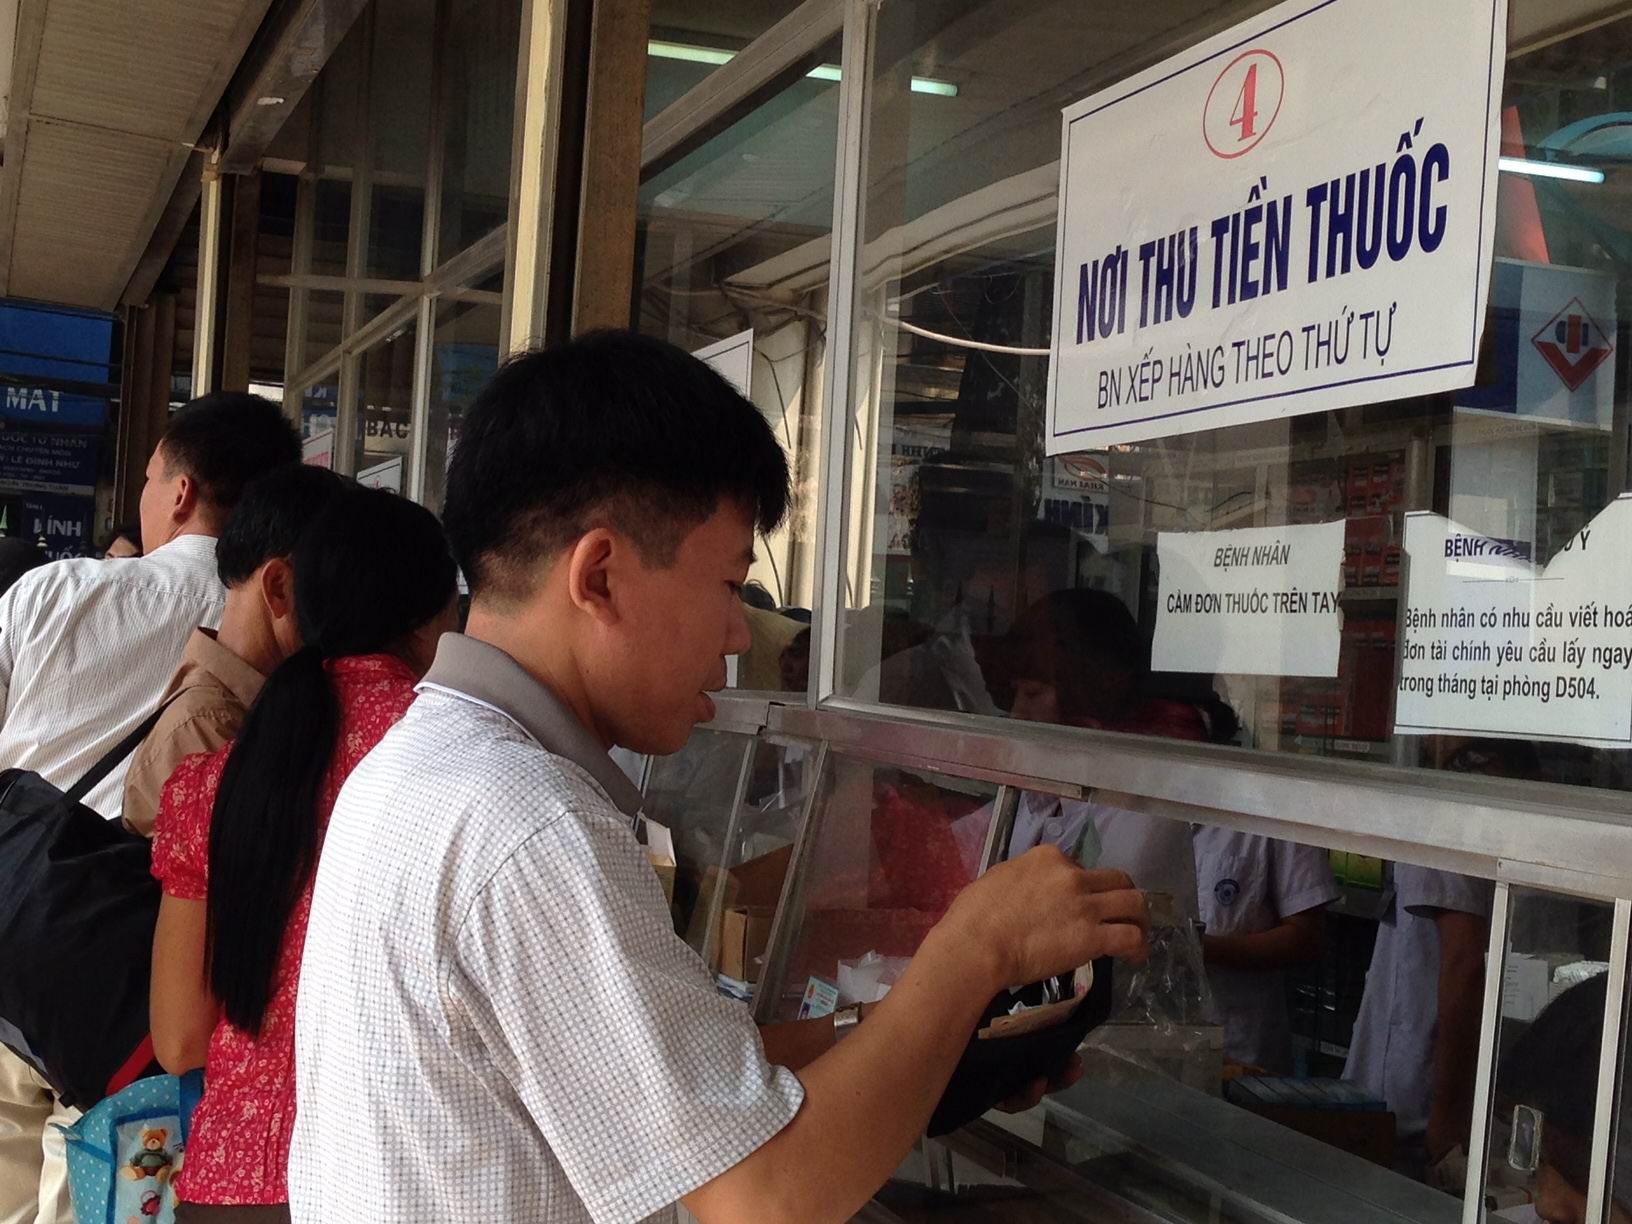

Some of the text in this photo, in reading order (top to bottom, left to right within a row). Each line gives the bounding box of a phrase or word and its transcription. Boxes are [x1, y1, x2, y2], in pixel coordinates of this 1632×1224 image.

[1229, 63, 1258, 142] 4
[1076, 117, 1450, 345] NƠI THU TIỀN THUỐC
[1097, 301, 1397, 409] BN XẾP HÀNG THEO THỨ TỰ
[1213, 540, 1291, 572] BỆNH NHÂN
[1444, 533, 1488, 563] BỆNH
[1194, 593, 1222, 614] ĐƠN
[1273, 587, 1308, 614] TRÊN
[1312, 592, 1340, 614] TAY
[1441, 605, 1475, 628] nhân
[1480, 606, 1498, 628] có
[1503, 606, 1530, 628] nhu
[1536, 602, 1563, 628] cầu
[1569, 601, 1598, 628] viết
[1430, 639, 1447, 661] tài
[1452, 640, 1491, 662] chính
[1496, 640, 1523, 667] yêu
[1529, 637, 1556, 663] cầu
[1563, 637, 1586, 669] lấy
[1592, 645, 1632, 670] ngay
[1398, 672, 1600, 703] trong tháng tại phòng D504.
